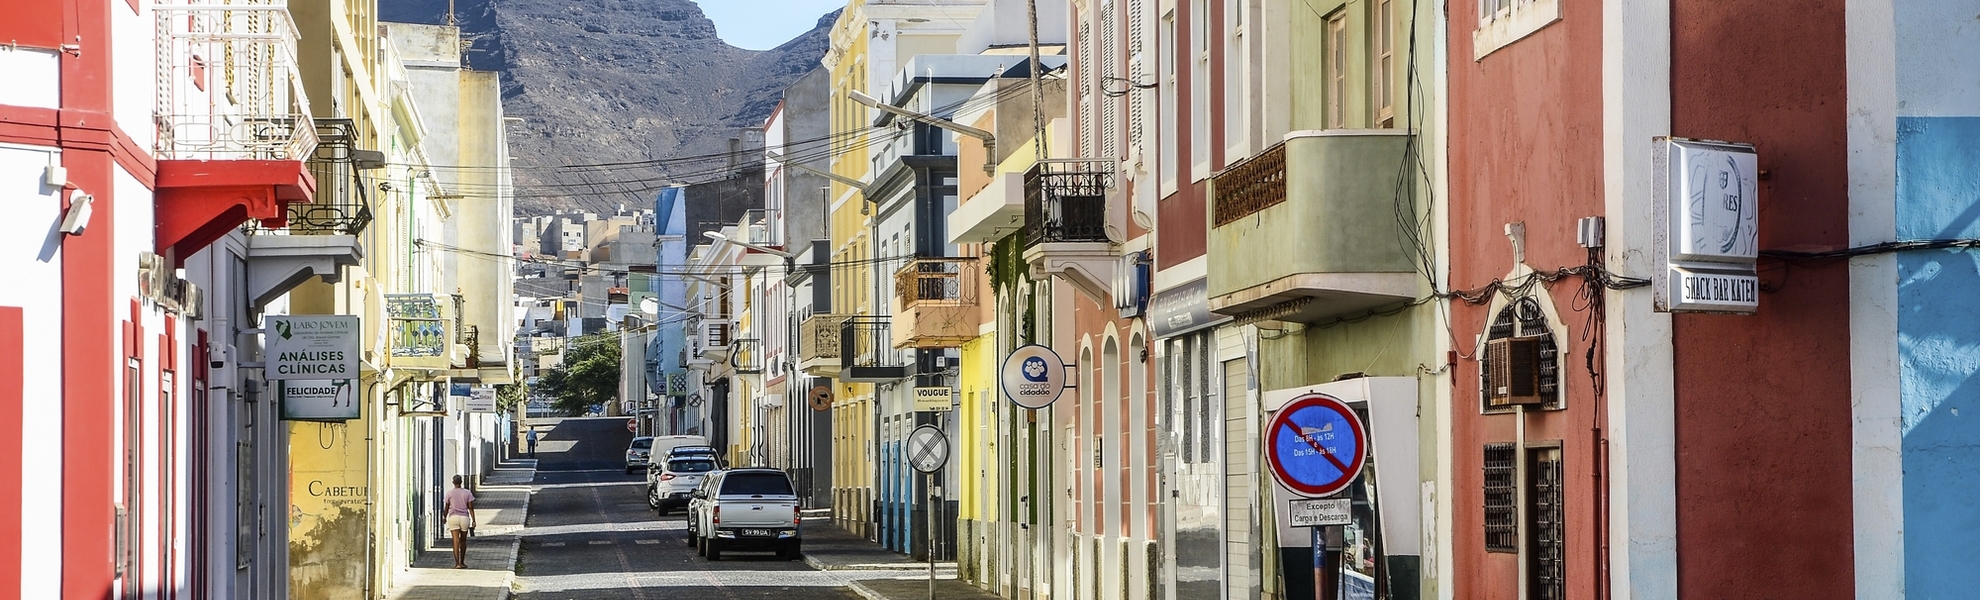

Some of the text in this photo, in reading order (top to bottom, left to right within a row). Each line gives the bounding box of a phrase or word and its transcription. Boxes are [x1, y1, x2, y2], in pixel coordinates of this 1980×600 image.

[1685, 276, 1711, 300] SNACK
[1713, 277, 1729, 301] BAR
[293, 321, 348, 330] LABO JOVEM
[278, 349, 344, 361] ANÁLISES
[278, 362, 345, 374] CLÍNICAS
[286, 387, 335, 395] FELICIDADE
[917, 389, 949, 397] VOUGUE
[1294, 435, 1305, 443] Das
[1324, 432, 1335, 440] 12H
[1305, 448, 1315, 456] 15H
[1294, 514, 1312, 523] Carga
[1319, 513, 1348, 522] Descarga
